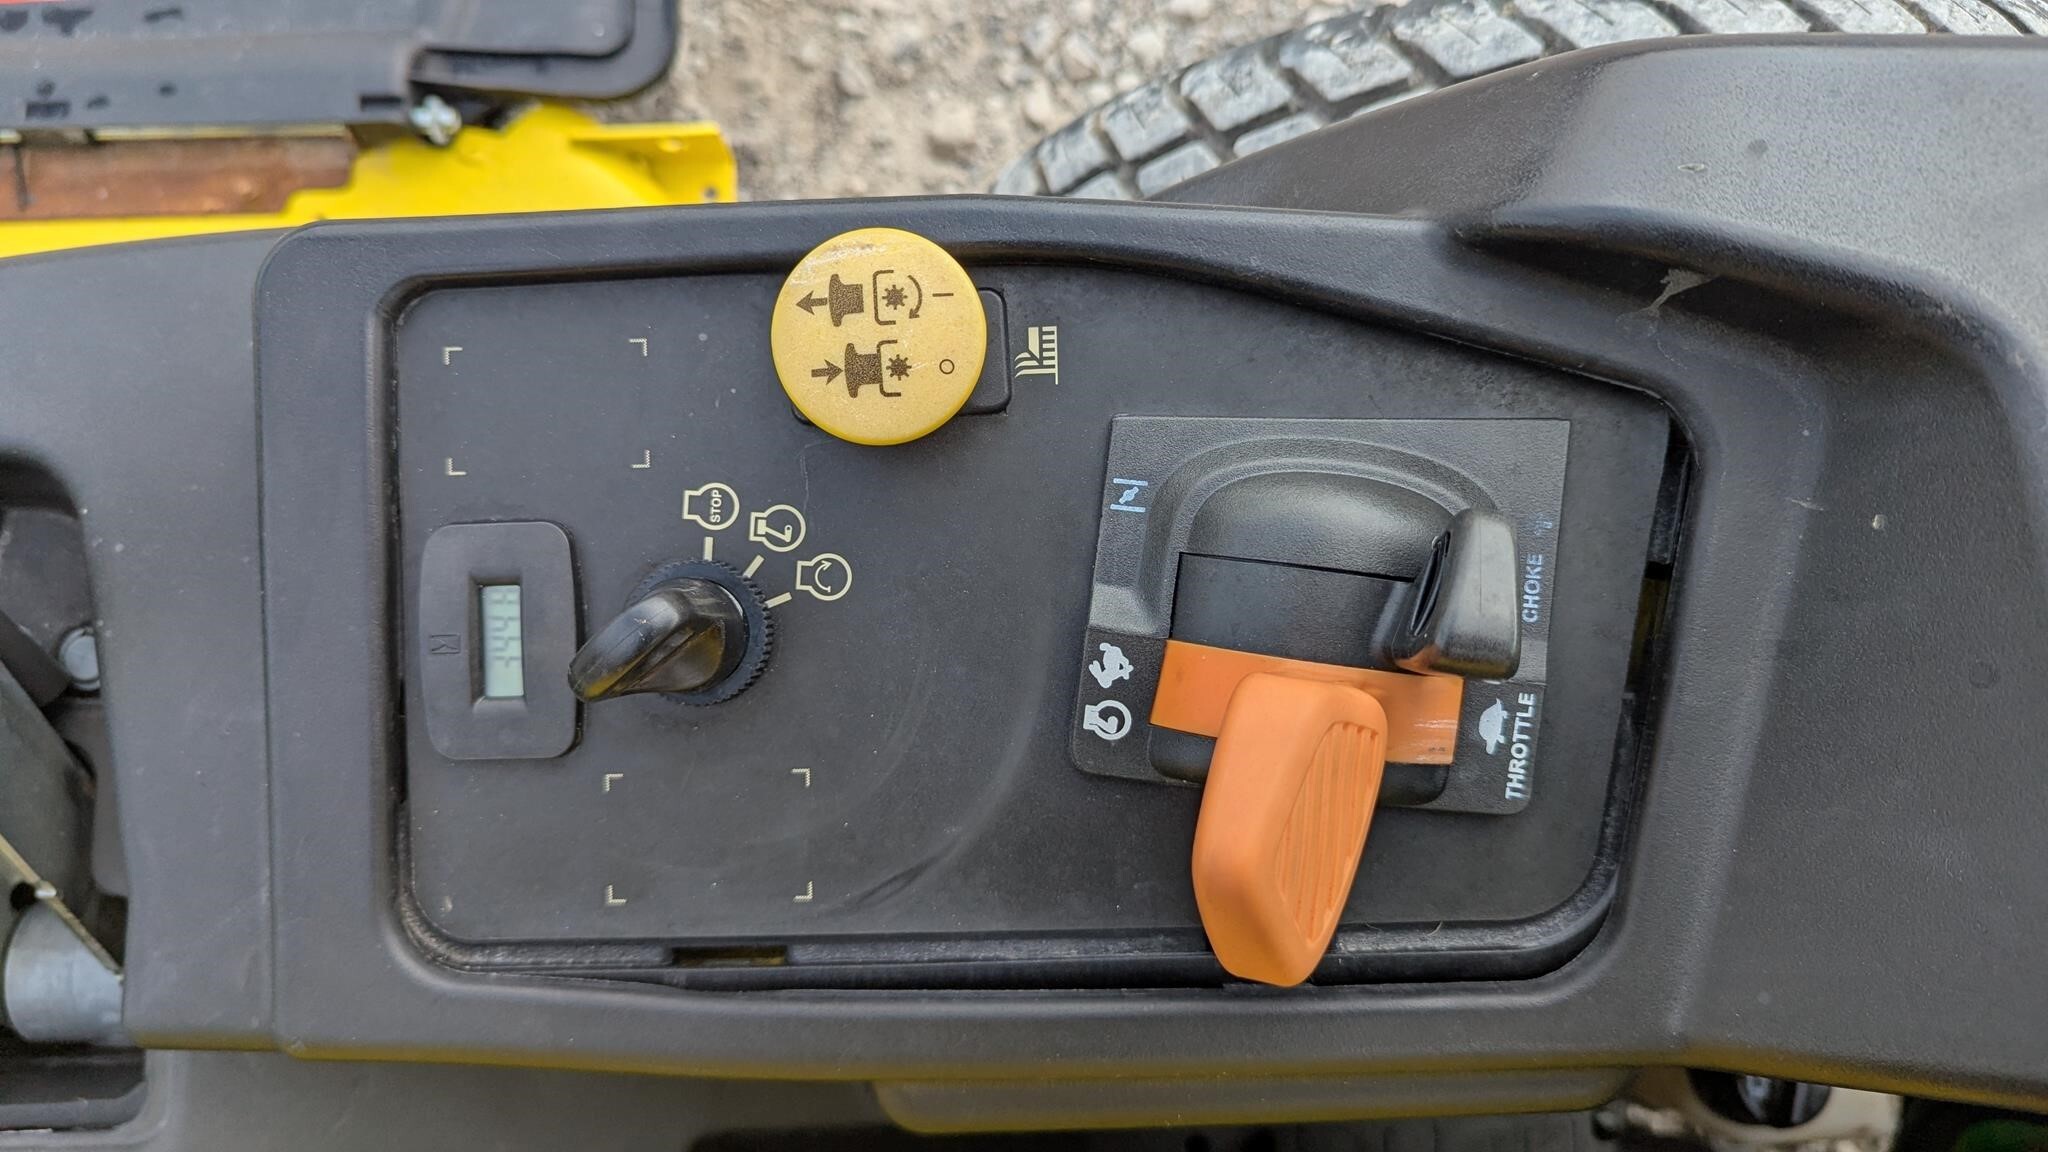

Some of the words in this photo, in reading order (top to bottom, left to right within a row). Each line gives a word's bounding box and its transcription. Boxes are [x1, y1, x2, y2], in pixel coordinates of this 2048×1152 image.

[710, 489, 722, 523] STOP
[1522, 553, 1543, 623] CHOKE
[1505, 692, 1536, 801] THROTTLE
